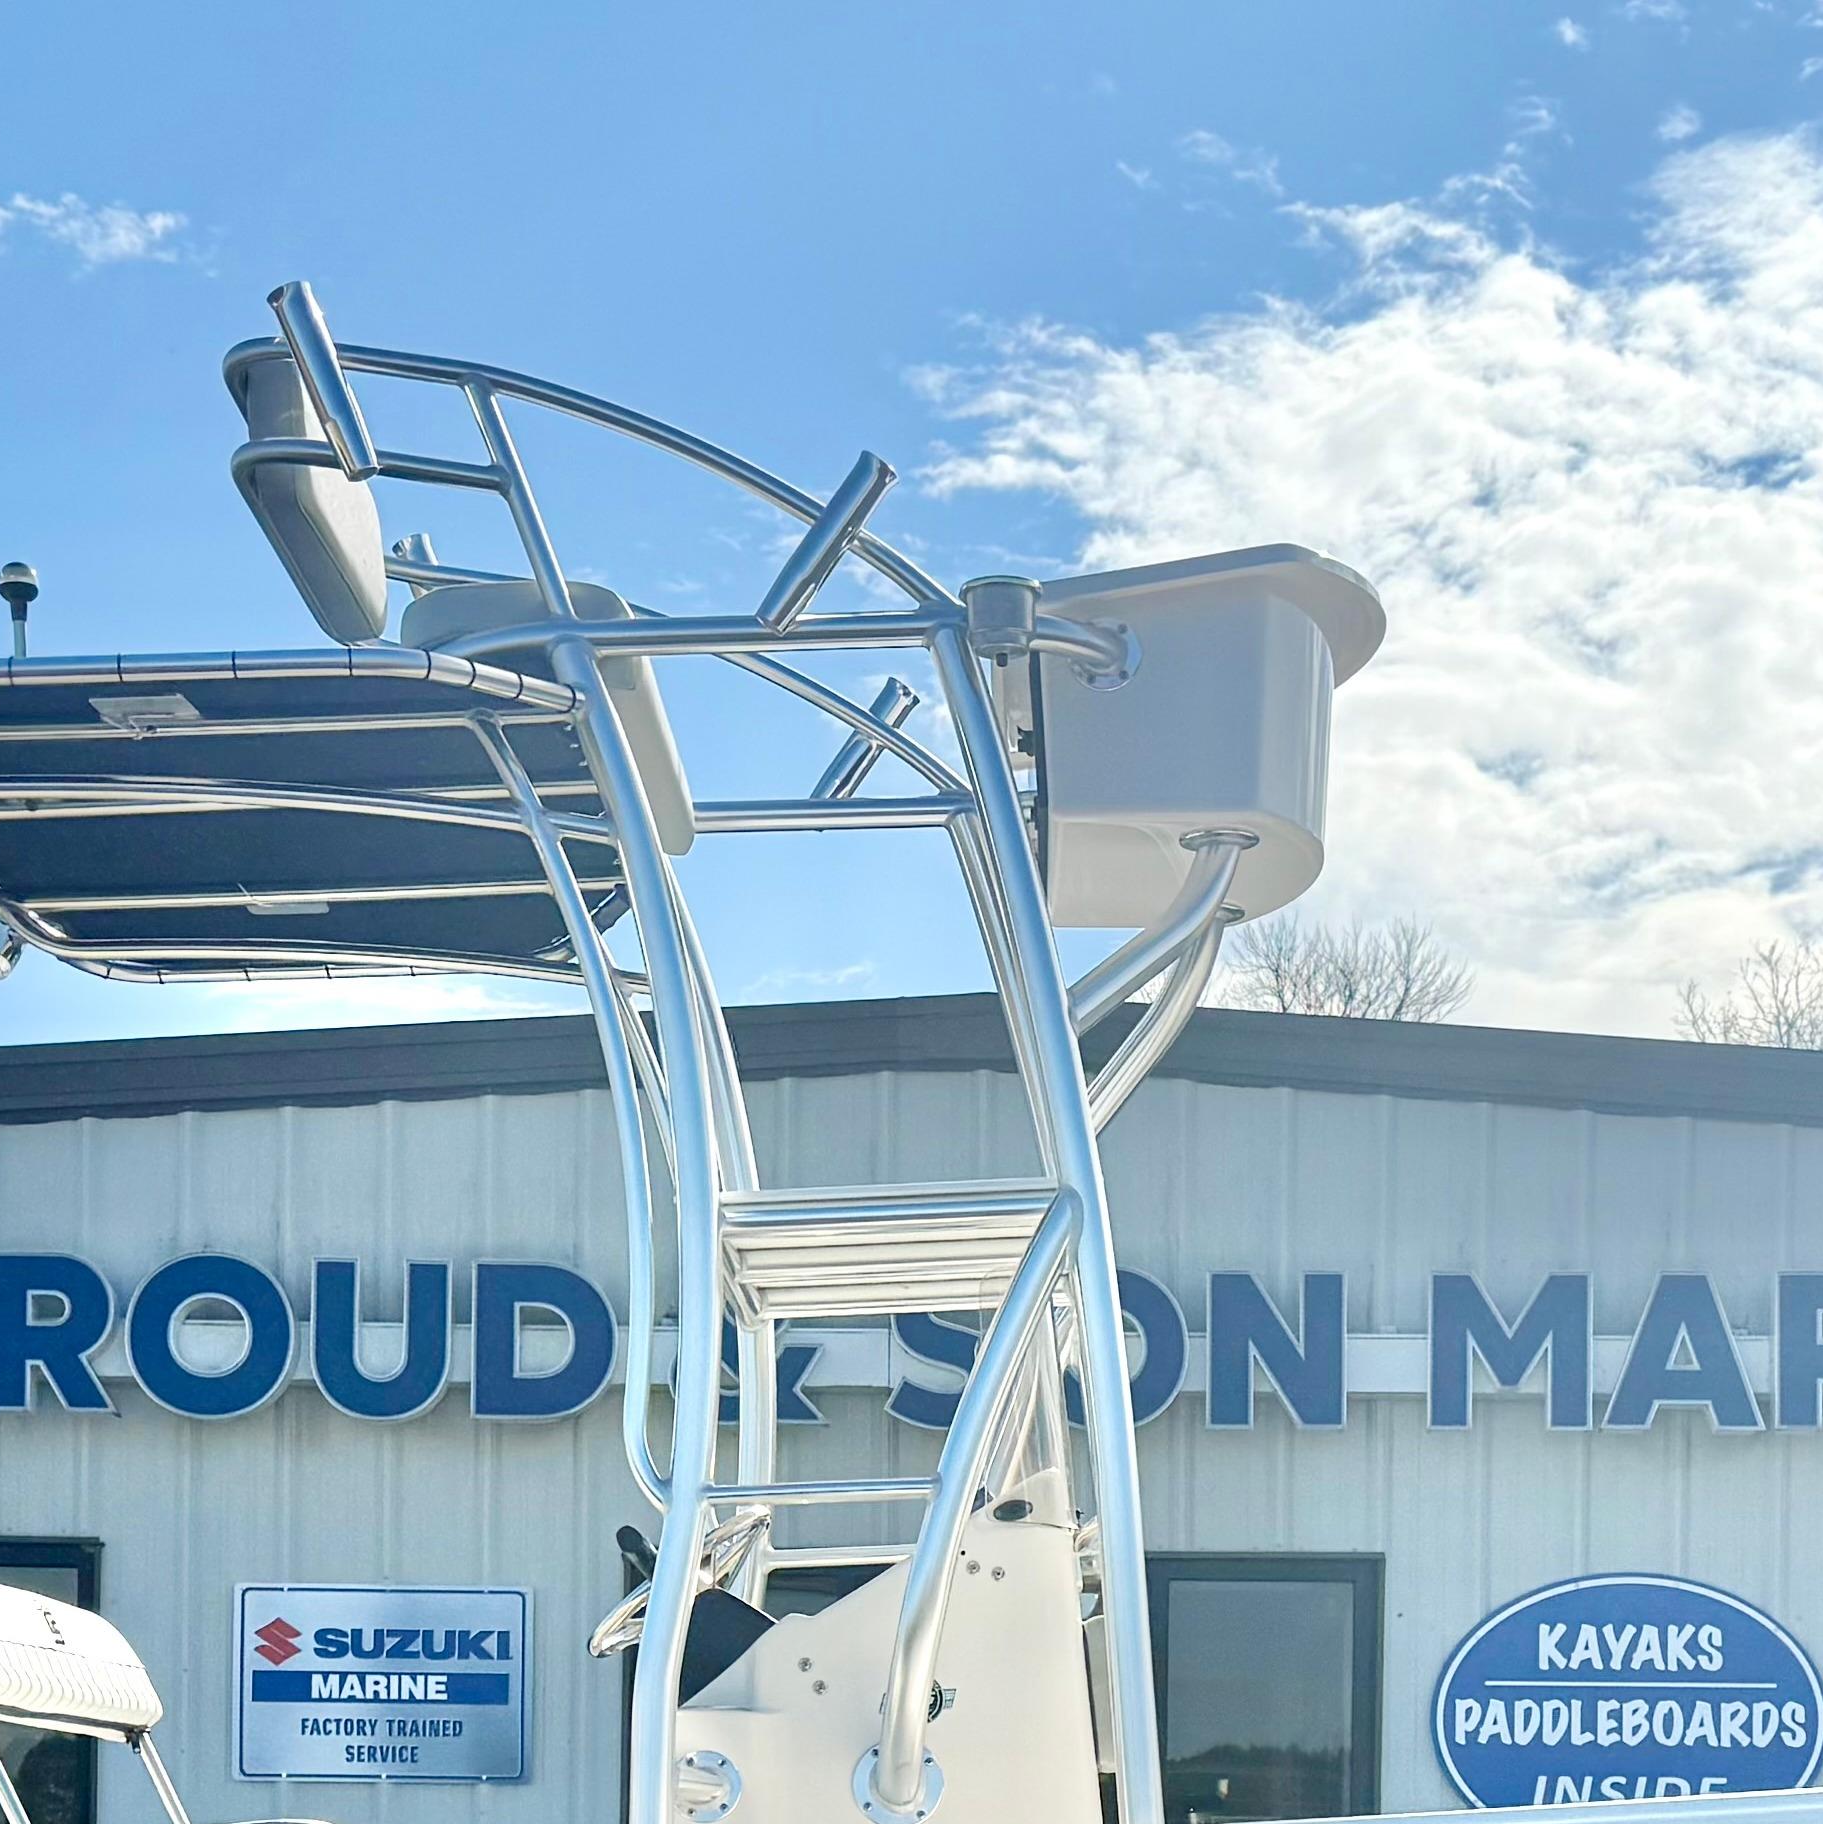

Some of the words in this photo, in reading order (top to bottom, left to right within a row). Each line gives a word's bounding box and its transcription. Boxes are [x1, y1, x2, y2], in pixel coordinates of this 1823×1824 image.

[313, 1628, 514, 1661] SUZUKI
[1538, 1623, 1724, 1671] KAYAKS
[311, 1673, 448, 1701] MARINE
[301, 1717, 377, 1737] FACTORY
[386, 1719, 463, 1738] TRAINED
[1454, 1698, 1807, 1748] PADDLEBOARDS
[345, 1745, 419, 1764] SERVICE
